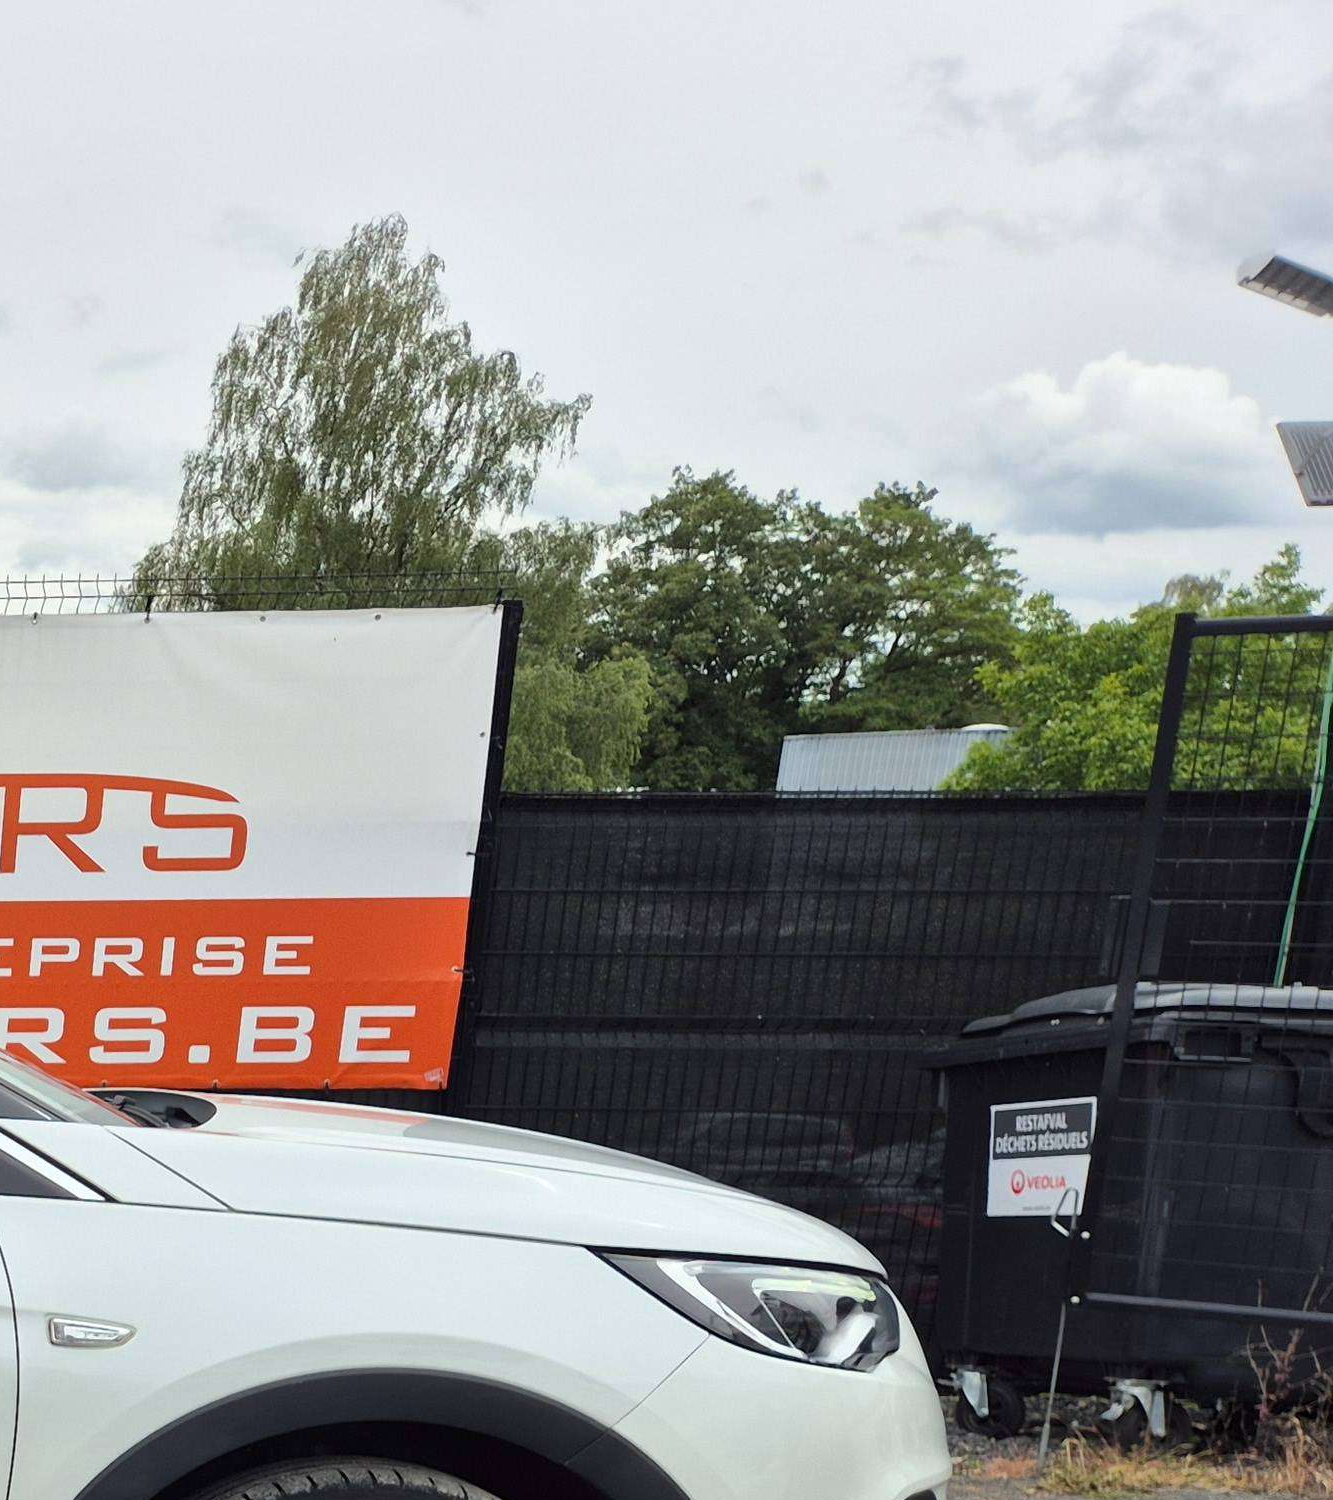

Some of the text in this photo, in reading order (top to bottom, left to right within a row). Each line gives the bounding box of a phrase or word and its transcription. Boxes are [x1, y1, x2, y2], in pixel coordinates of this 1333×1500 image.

[1015, 1112, 1068, 1132] RESTAFVAL
[995, 1130, 1088, 1154] DÉCHETS RÉSIDUELS
[1027, 1175, 1067, 1189] VEOLIA
